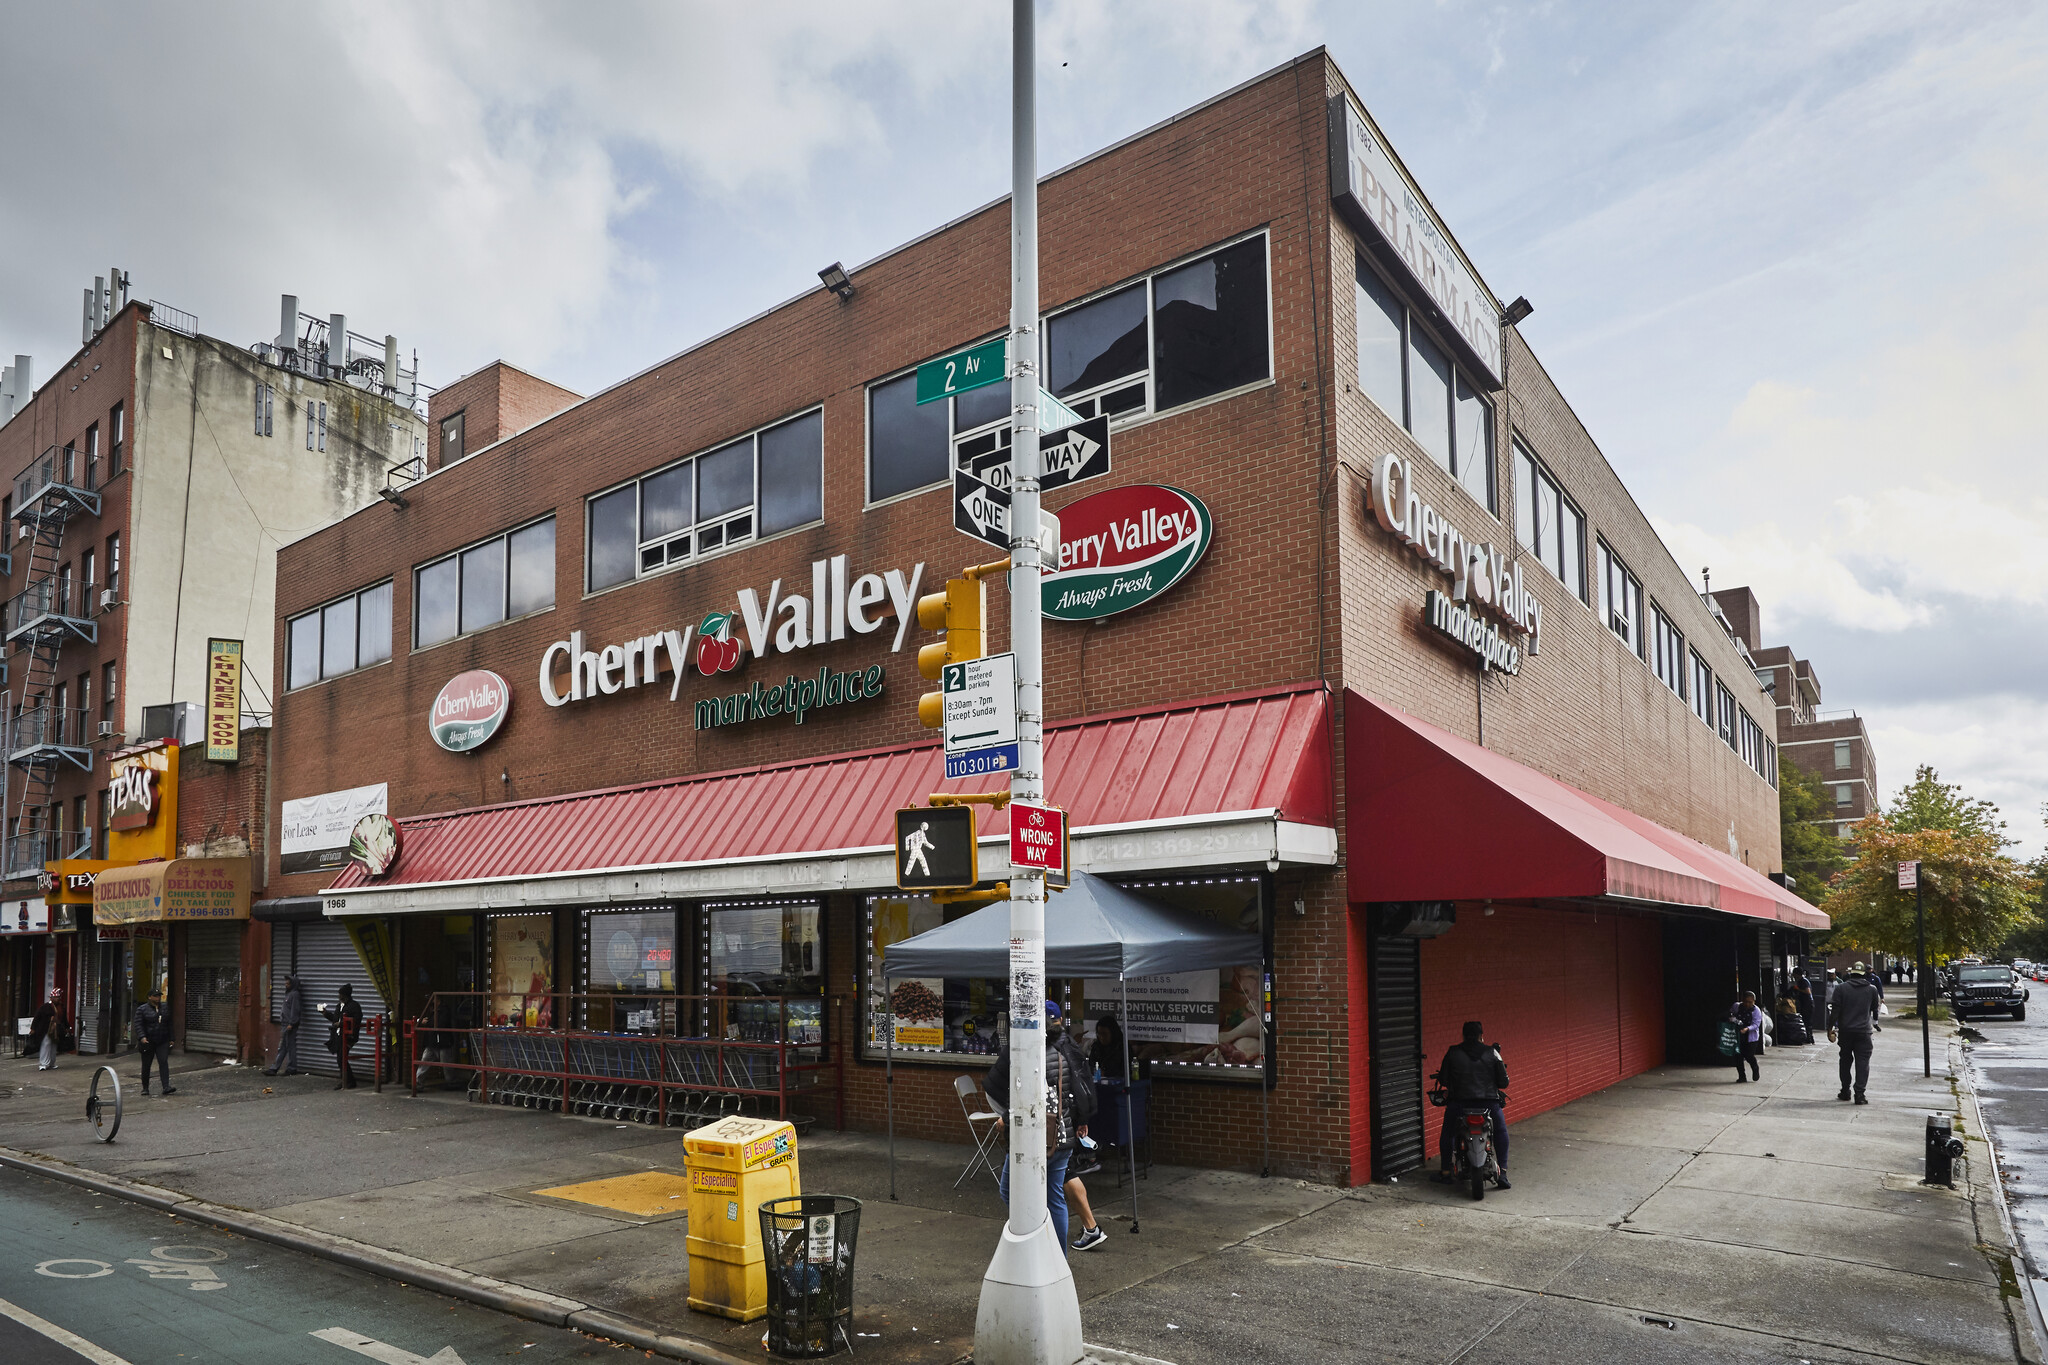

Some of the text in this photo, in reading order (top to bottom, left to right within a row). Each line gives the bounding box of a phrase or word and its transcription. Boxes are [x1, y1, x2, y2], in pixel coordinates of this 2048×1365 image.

[1403, 189, 1456, 274] METROPOLITAN
[1358, 156, 1501, 375] PHARMACY
[944, 355, 980, 393] 2 Av
[1042, 398, 1049, 426] E
[991, 440, 1086, 488] ON WAY
[972, 497, 1003, 530] ONE
[1058, 530, 1108, 569] erry
[1109, 507, 1189, 553] Valley
[1372, 453, 1541, 655] Cherry Valley
[1055, 571, 1152, 610] Always Fresh
[540, 553, 926, 707] Cherry Valley
[1431, 590, 1519, 676] marketplace
[211, 642, 239, 654] GOOD TASTE
[949, 665, 981, 690] 2 hour
[968, 670, 993, 681] metered
[968, 679, 990, 691] parking
[212, 655, 235, 745] CHINESE FOOD
[438, 684, 500, 717] Cherry Valley
[694, 664, 885, 731] marketplace
[947, 700, 972, 711] 8:30am
[979, 697, 993, 706] 7pm
[948, 706, 997, 722] Except Sunday
[448, 724, 484, 746] Always Fresh
[209, 748, 237, 759] 996-6931
[948, 756, 990, 776] 110301
[109, 766, 152, 817] TEXAS
[283, 824, 295, 840] For
[296, 823, 318, 838] Lease
[1020, 827, 1054, 846] WRONG
[1026, 846, 1047, 862] WAY
[36, 872, 53, 890] TEXAS
[67, 872, 99, 889] TEX
[100, 878, 151, 901] DELICIOUS
[167, 879, 234, 890] DELICIOUS
[167, 908, 235, 916] 212-996-6931
[327, 899, 346, 908] 1968
[99, 928, 130, 938] ATM
[134, 927, 164, 938] ATM
[1126, 976, 1171, 984] WIRELESS
[1112, 987, 1148, 995] AUTORIZED
[1089, 1002, 1114, 1011] FREE
[1168, 1004, 1214, 1014] SERVICE
[1122, 1024, 1182, 1033] ndupwireless.com
[744, 1145, 752, 1159] El
[754, 1129, 793, 1155] Especto
[770, 1152, 793, 1168] GRATIS
[694, 1172, 736, 1188] El Especialito
